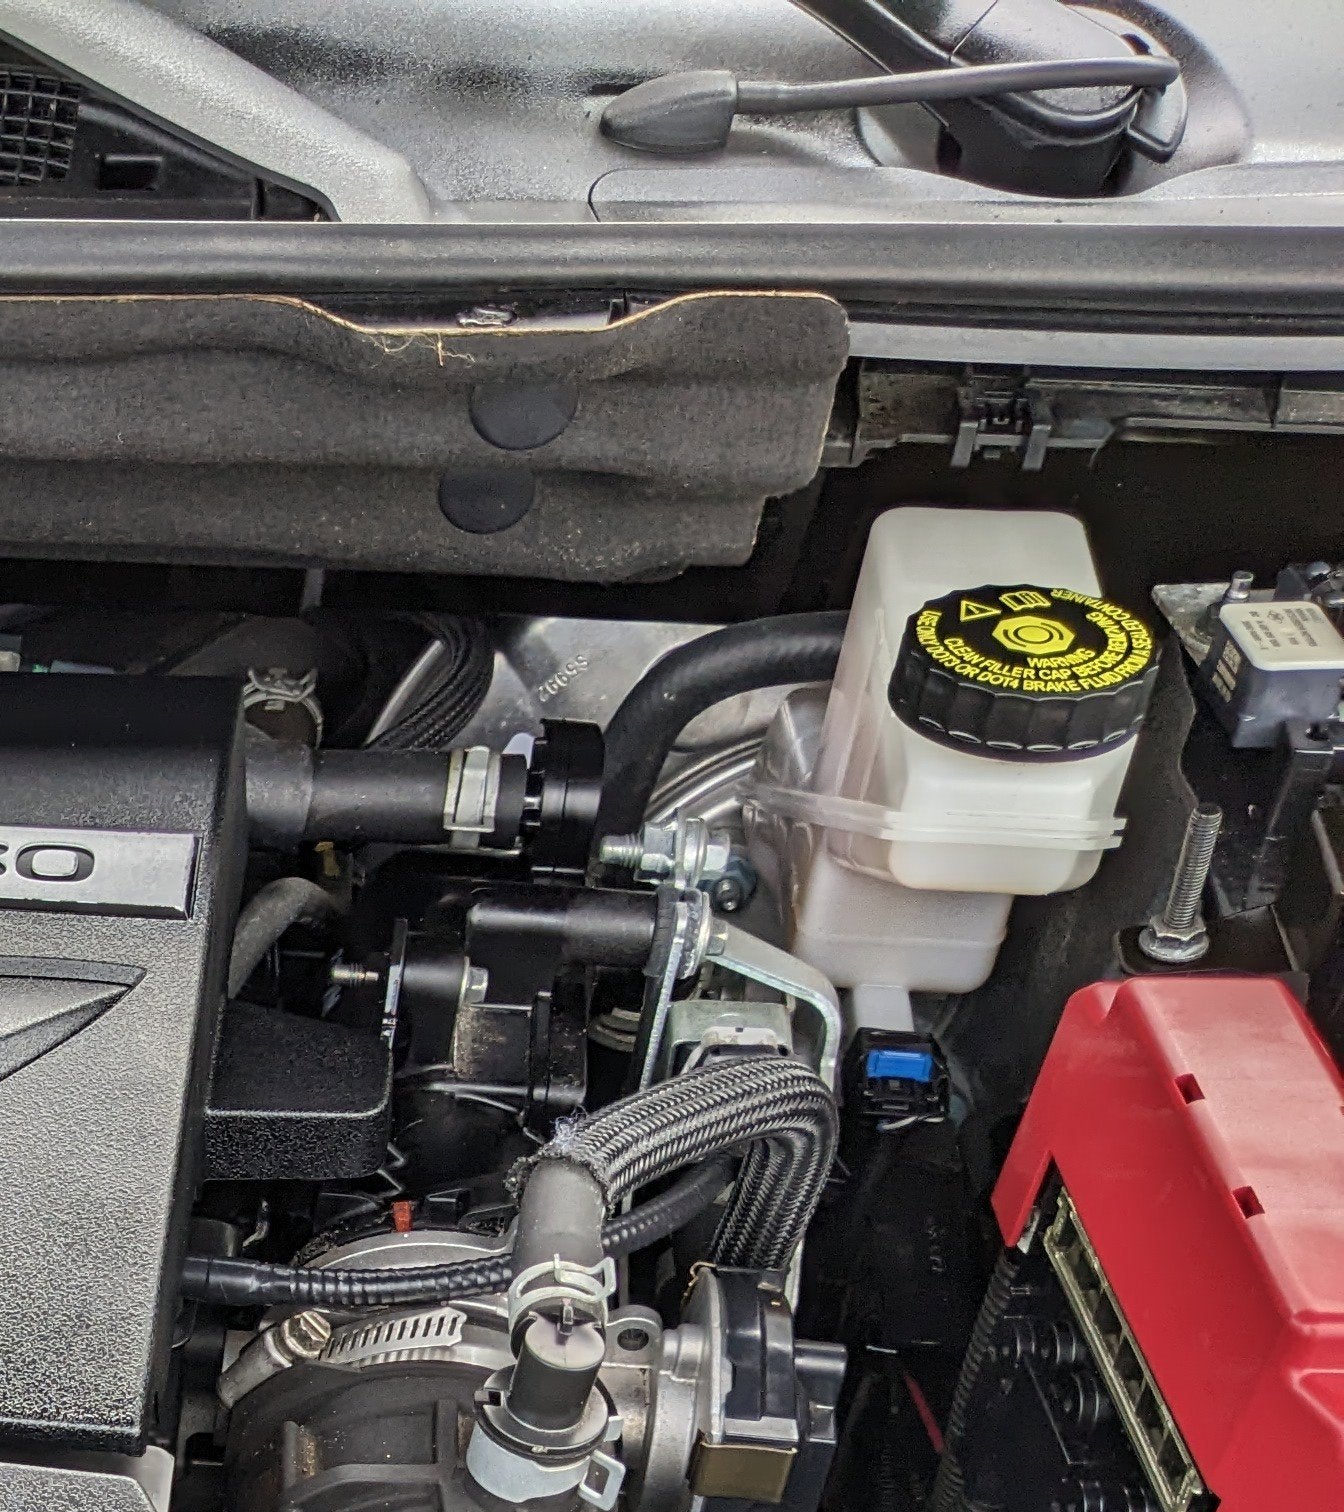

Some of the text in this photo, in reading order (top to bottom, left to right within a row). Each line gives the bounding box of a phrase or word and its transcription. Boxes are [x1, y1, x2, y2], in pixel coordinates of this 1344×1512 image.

[944, 637, 986, 665] CLEAN
[982, 659, 1036, 680] FILLER
[1038, 669, 1072, 680] CAP
[1071, 650, 1124, 677] BEFORE
[1027, 647, 1096, 668] WARNING
[954, 663, 980, 678] OR
[977, 671, 1019, 689] DOT4
[1023, 679, 1081, 692] BRAKE
[1078, 671, 1123, 690] FLUID
